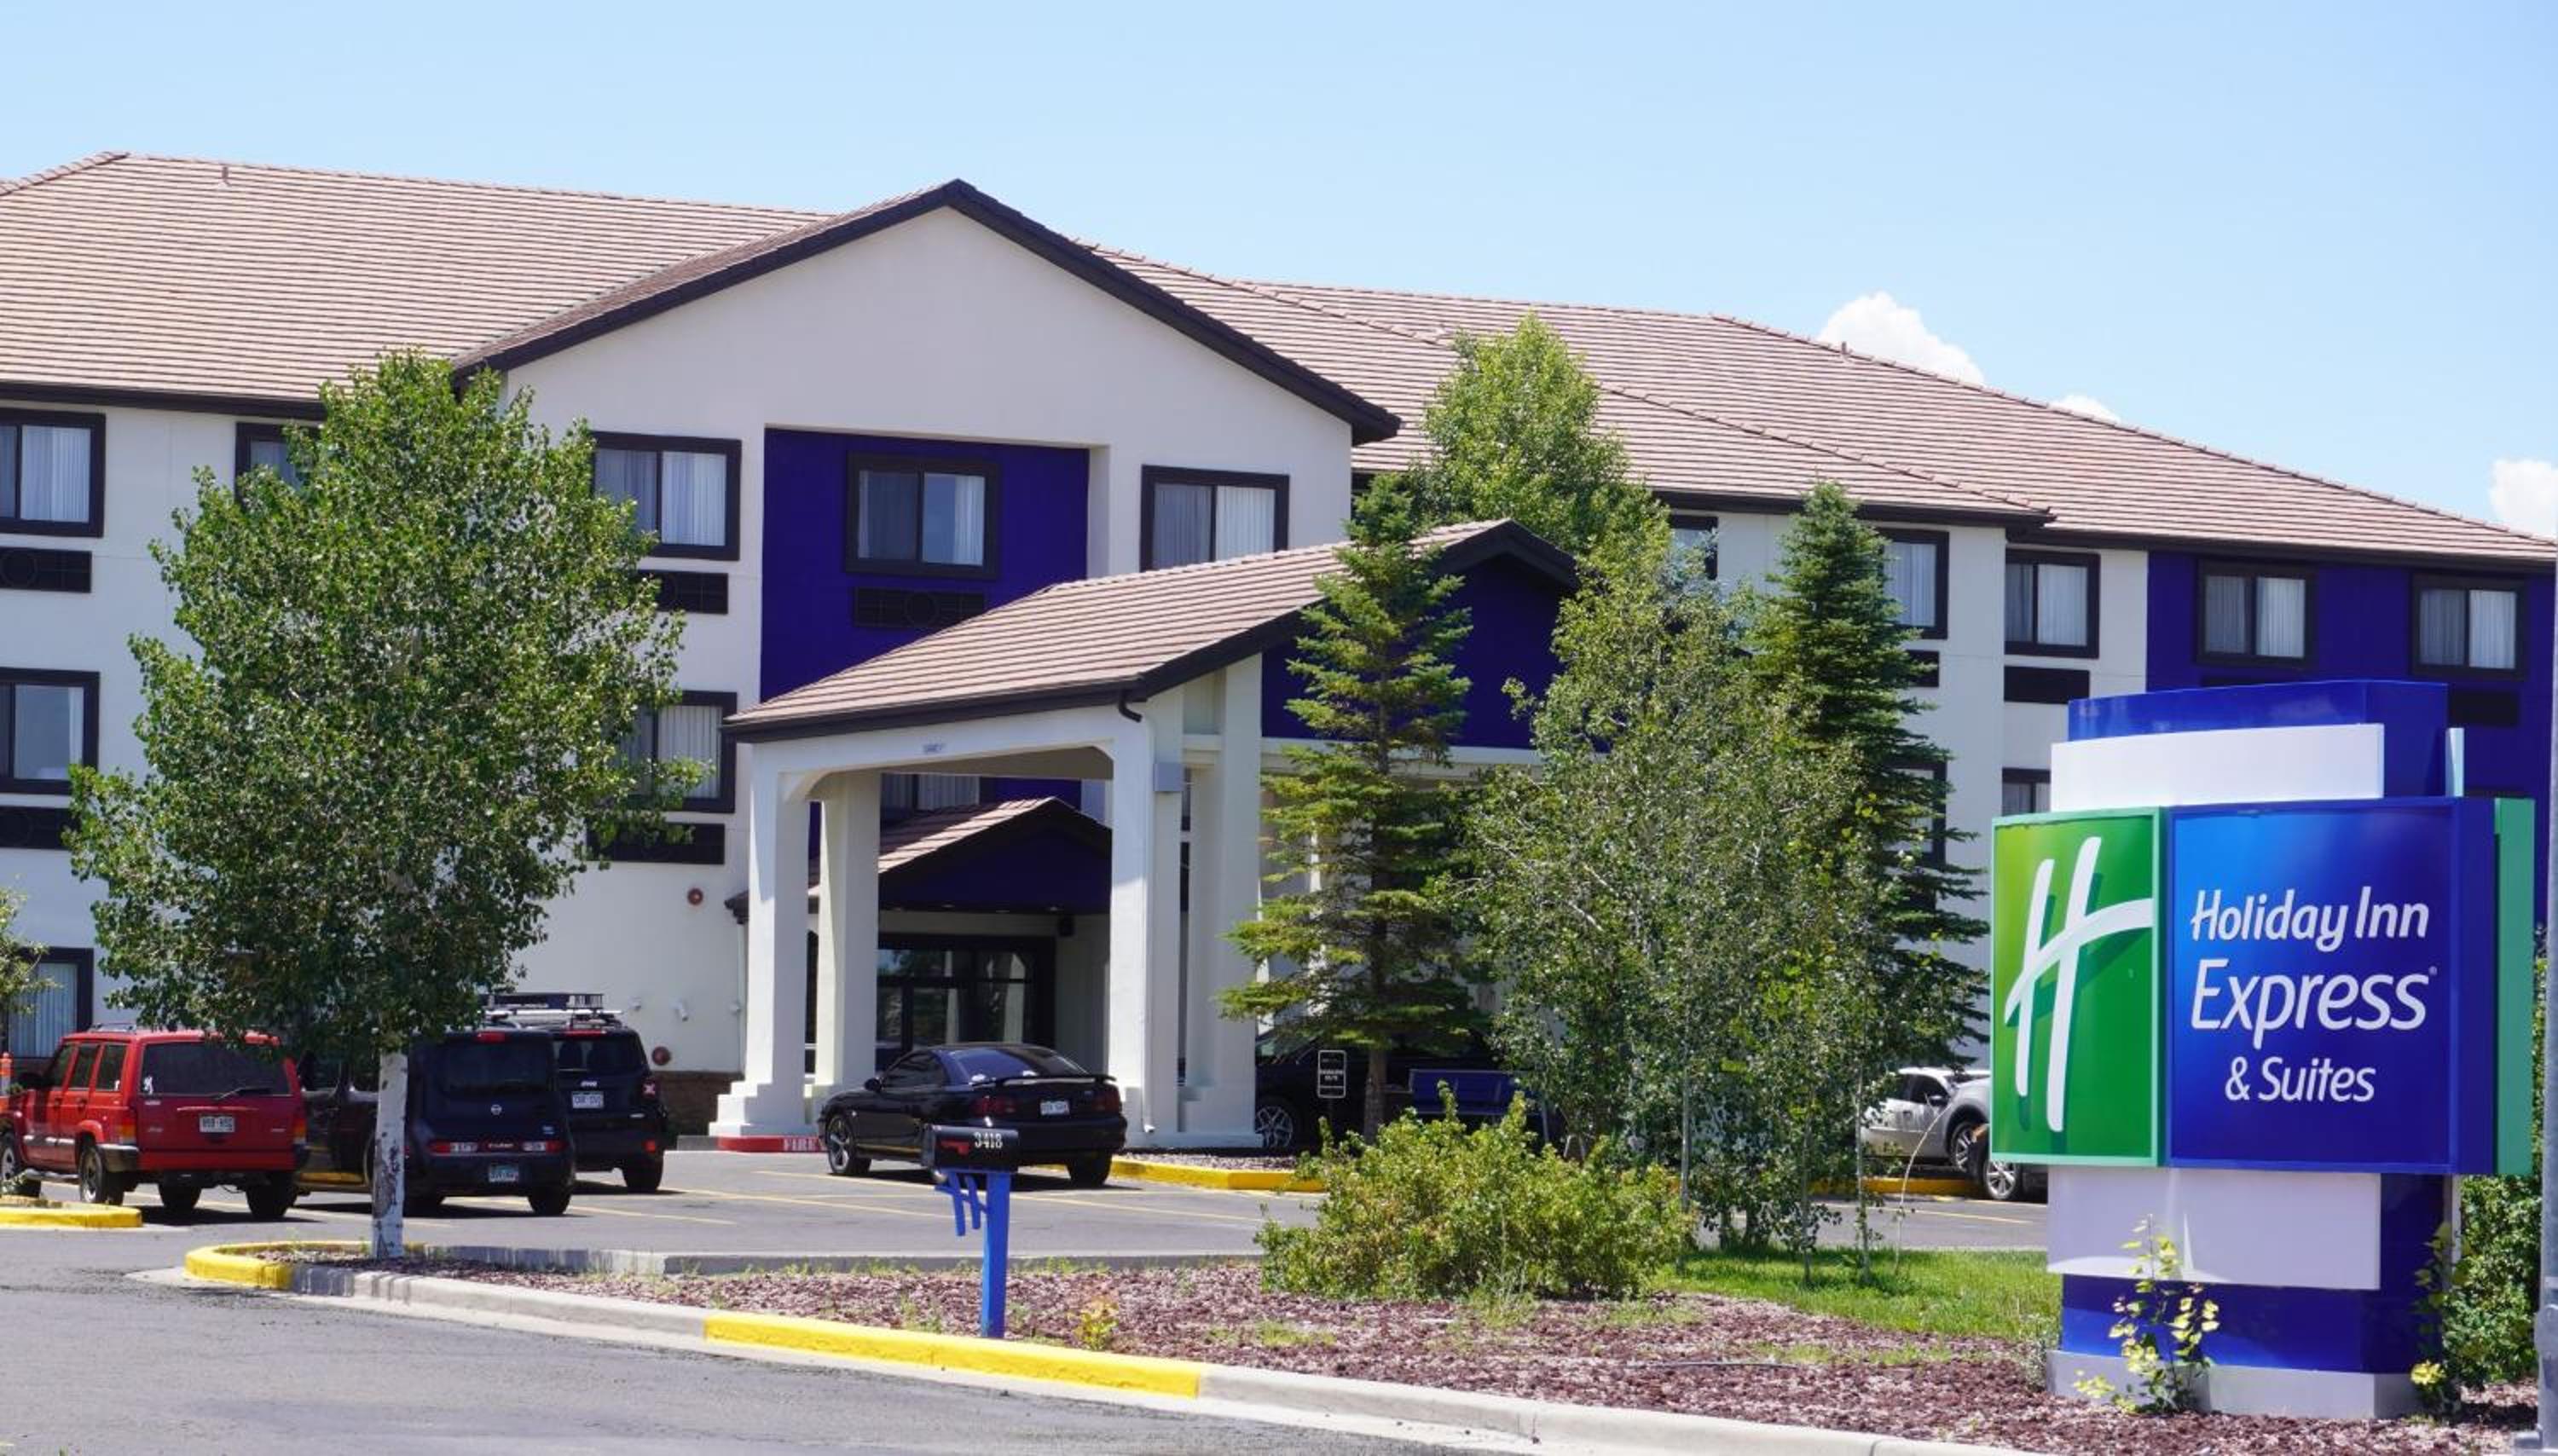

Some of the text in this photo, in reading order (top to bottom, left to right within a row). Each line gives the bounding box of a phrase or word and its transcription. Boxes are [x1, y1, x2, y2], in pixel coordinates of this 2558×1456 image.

[2191, 886, 2429, 952] Holiday Inn
[2191, 957, 2430, 1050] Express
[2225, 1056, 2376, 1102] & Suites
[973, 1131, 1004, 1149] 3418
